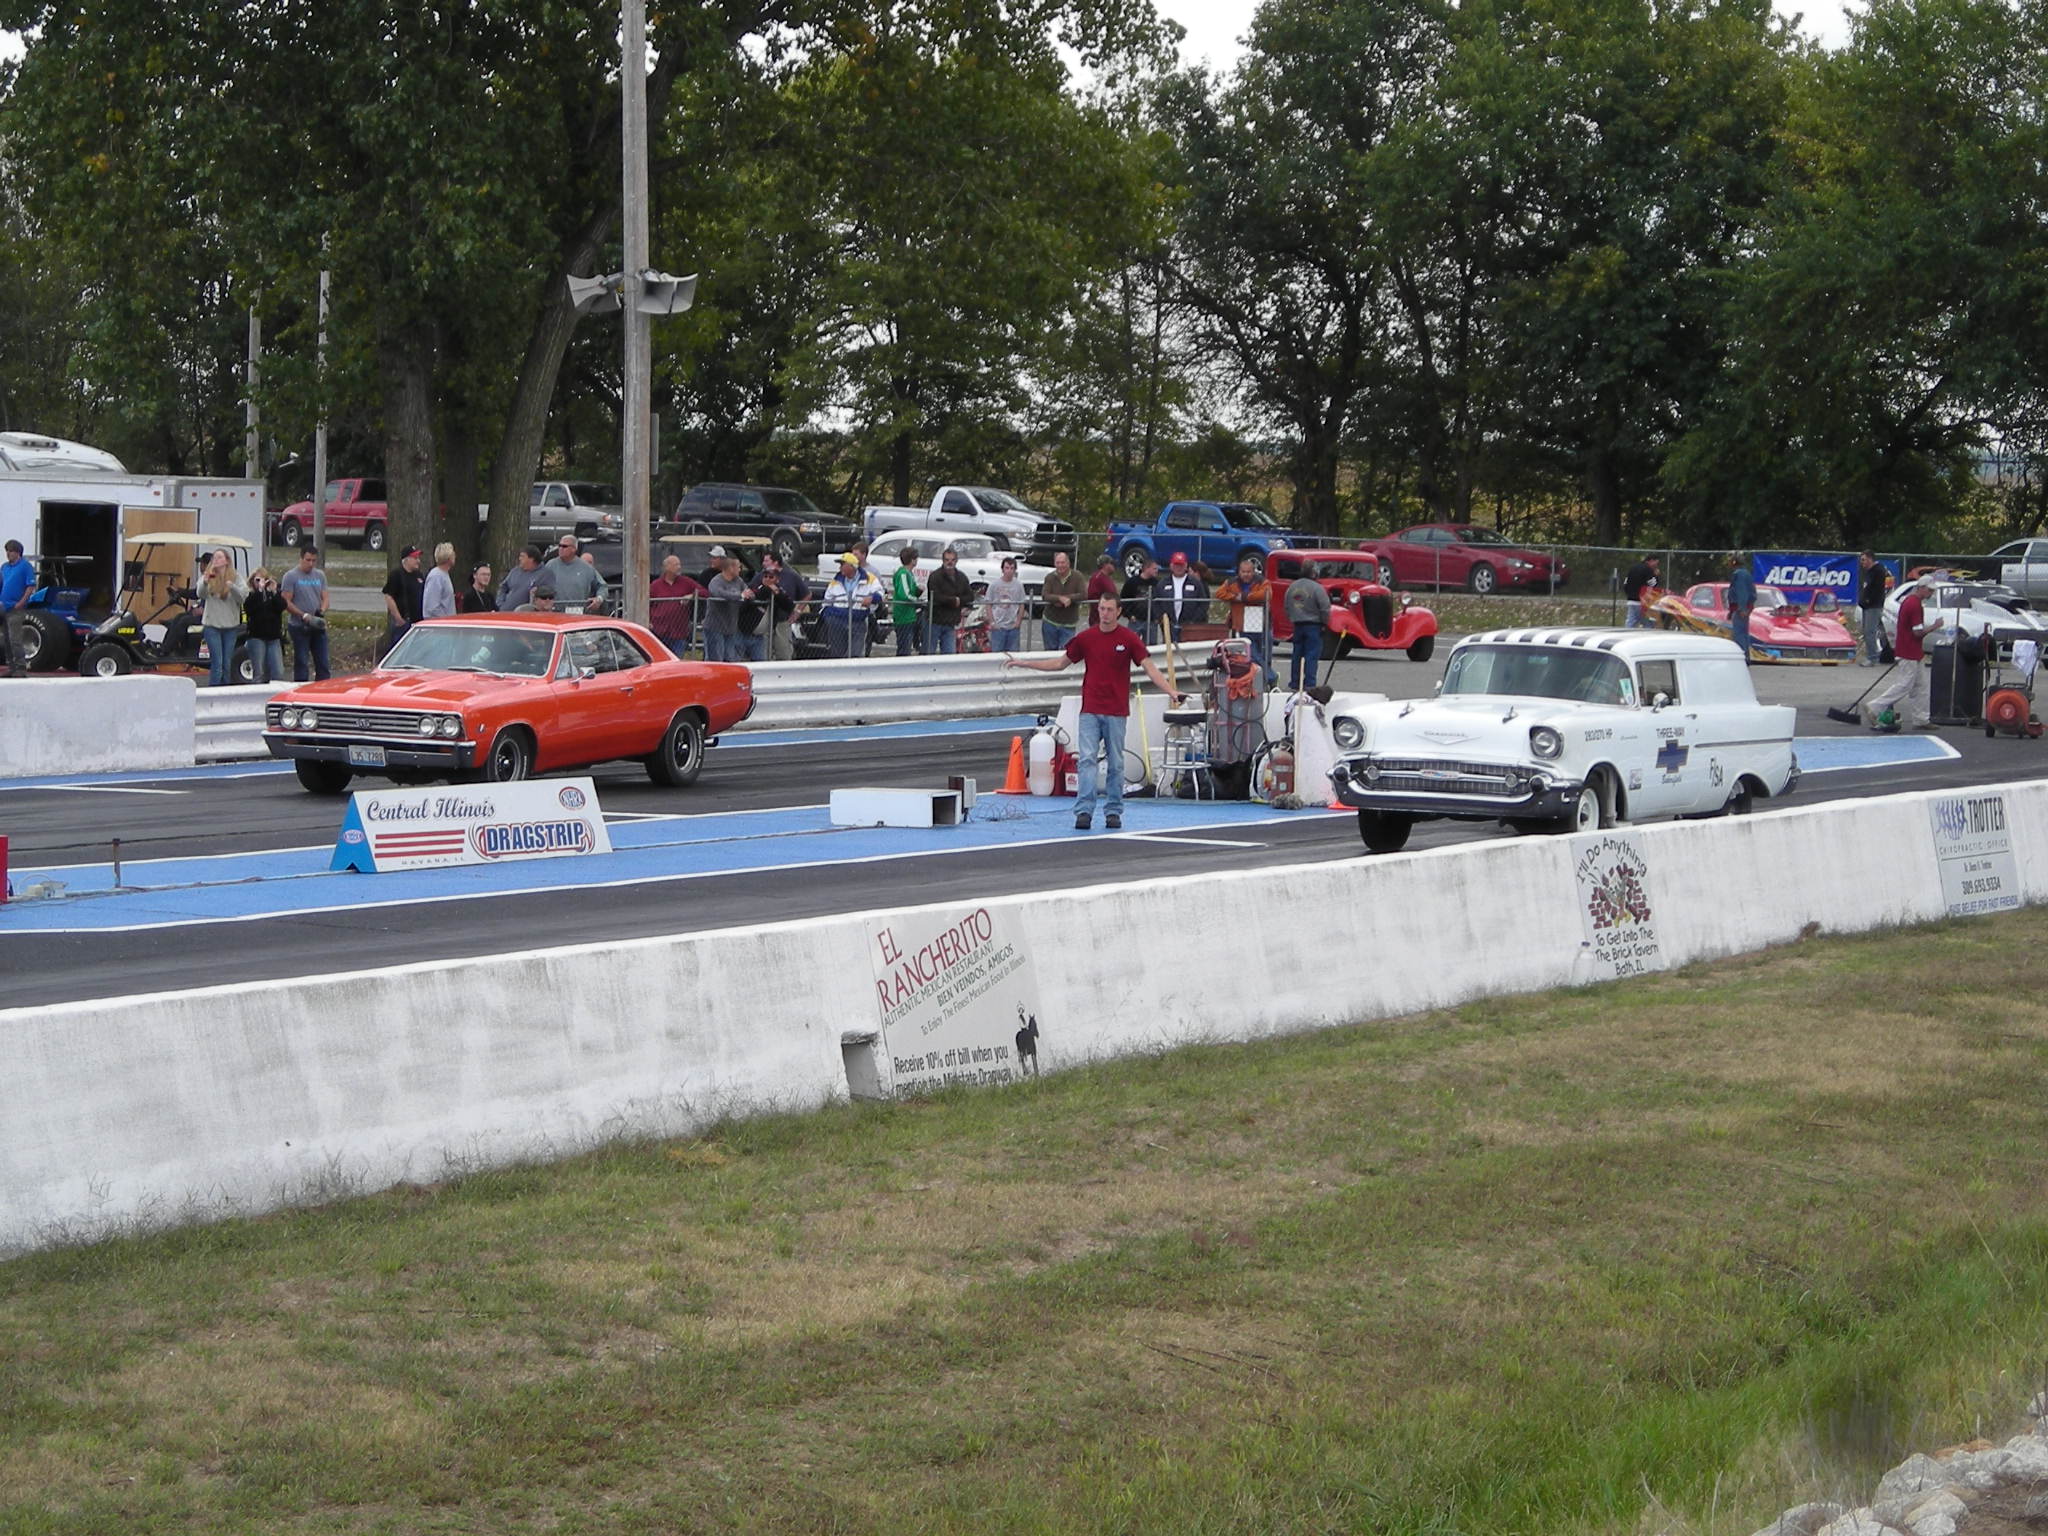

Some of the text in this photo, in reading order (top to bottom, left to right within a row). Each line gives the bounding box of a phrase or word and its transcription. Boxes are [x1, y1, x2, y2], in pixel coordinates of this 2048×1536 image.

[1764, 566, 1851, 586] ACDelco
[366, 797, 496, 821] Central Illinois
[1967, 797, 2005, 834] TROTTER
[485, 820, 586, 853] DRAGSTRIP
[1586, 845, 1601, 864] Do
[1602, 837, 1648, 878] Anything
[877, 927, 903, 966] EL
[1595, 926, 1655, 947] To Get Into The
[1595, 943, 1659, 962] The Brick Tavern
[877, 908, 992, 1013] RANCHERITO
[936, 989, 955, 1008] BIEN
[986, 943, 1014, 970] AMIGOS
[884, 940, 994, 1029] AUTHENTIC MEXICAN RESTAURANT
[928, 1016, 944, 1033] Enjoy
[942, 1008, 954, 1021] The
[953, 996, 969, 1013] Finest
[968, 983, 991, 1002] Mexican
[990, 972, 1005, 987] Food
[894, 1045, 1008, 1075] Receive 10% off bill when you
[928, 1072, 942, 1090] the
